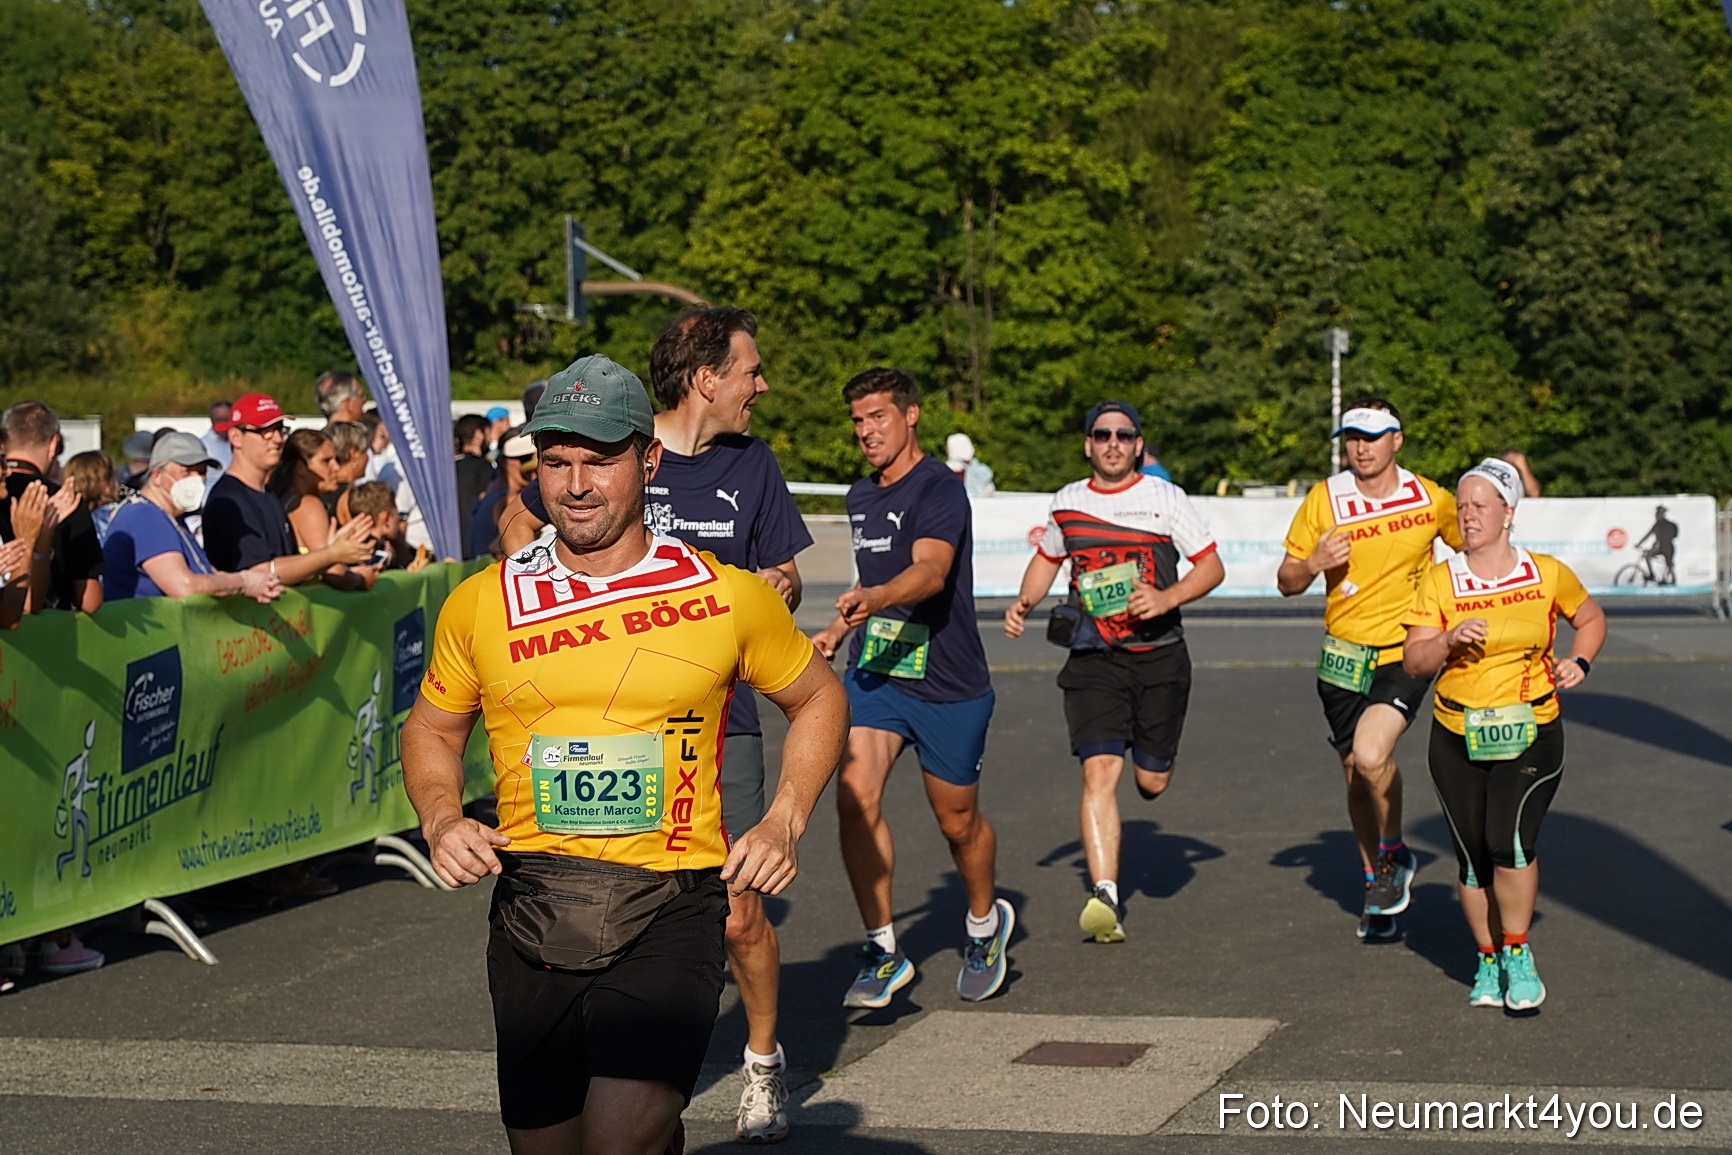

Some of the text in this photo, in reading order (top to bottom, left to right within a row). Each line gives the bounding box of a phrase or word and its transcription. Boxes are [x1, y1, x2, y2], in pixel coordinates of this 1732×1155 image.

[551, 392, 602, 406] BECK'S
[672, 518, 735, 531] Firmenlauf
[1388, 511, 1436, 533] BÖGL
[1095, 582, 1126, 601] 128
[1455, 589, 1546, 612] MAX BÖGL
[508, 594, 730, 664] MAX BÖGL
[133, 685, 176, 714] Fischer
[1477, 722, 1526, 744] 1007
[563, 753, 604, 763] Firmenlauf
[97, 723, 225, 839] firmenlauf
[553, 769, 642, 802] 1623
[539, 780, 551, 814] RUN
[645, 773, 657, 818] 2022
[554, 805, 642, 816] Kastner Marco
